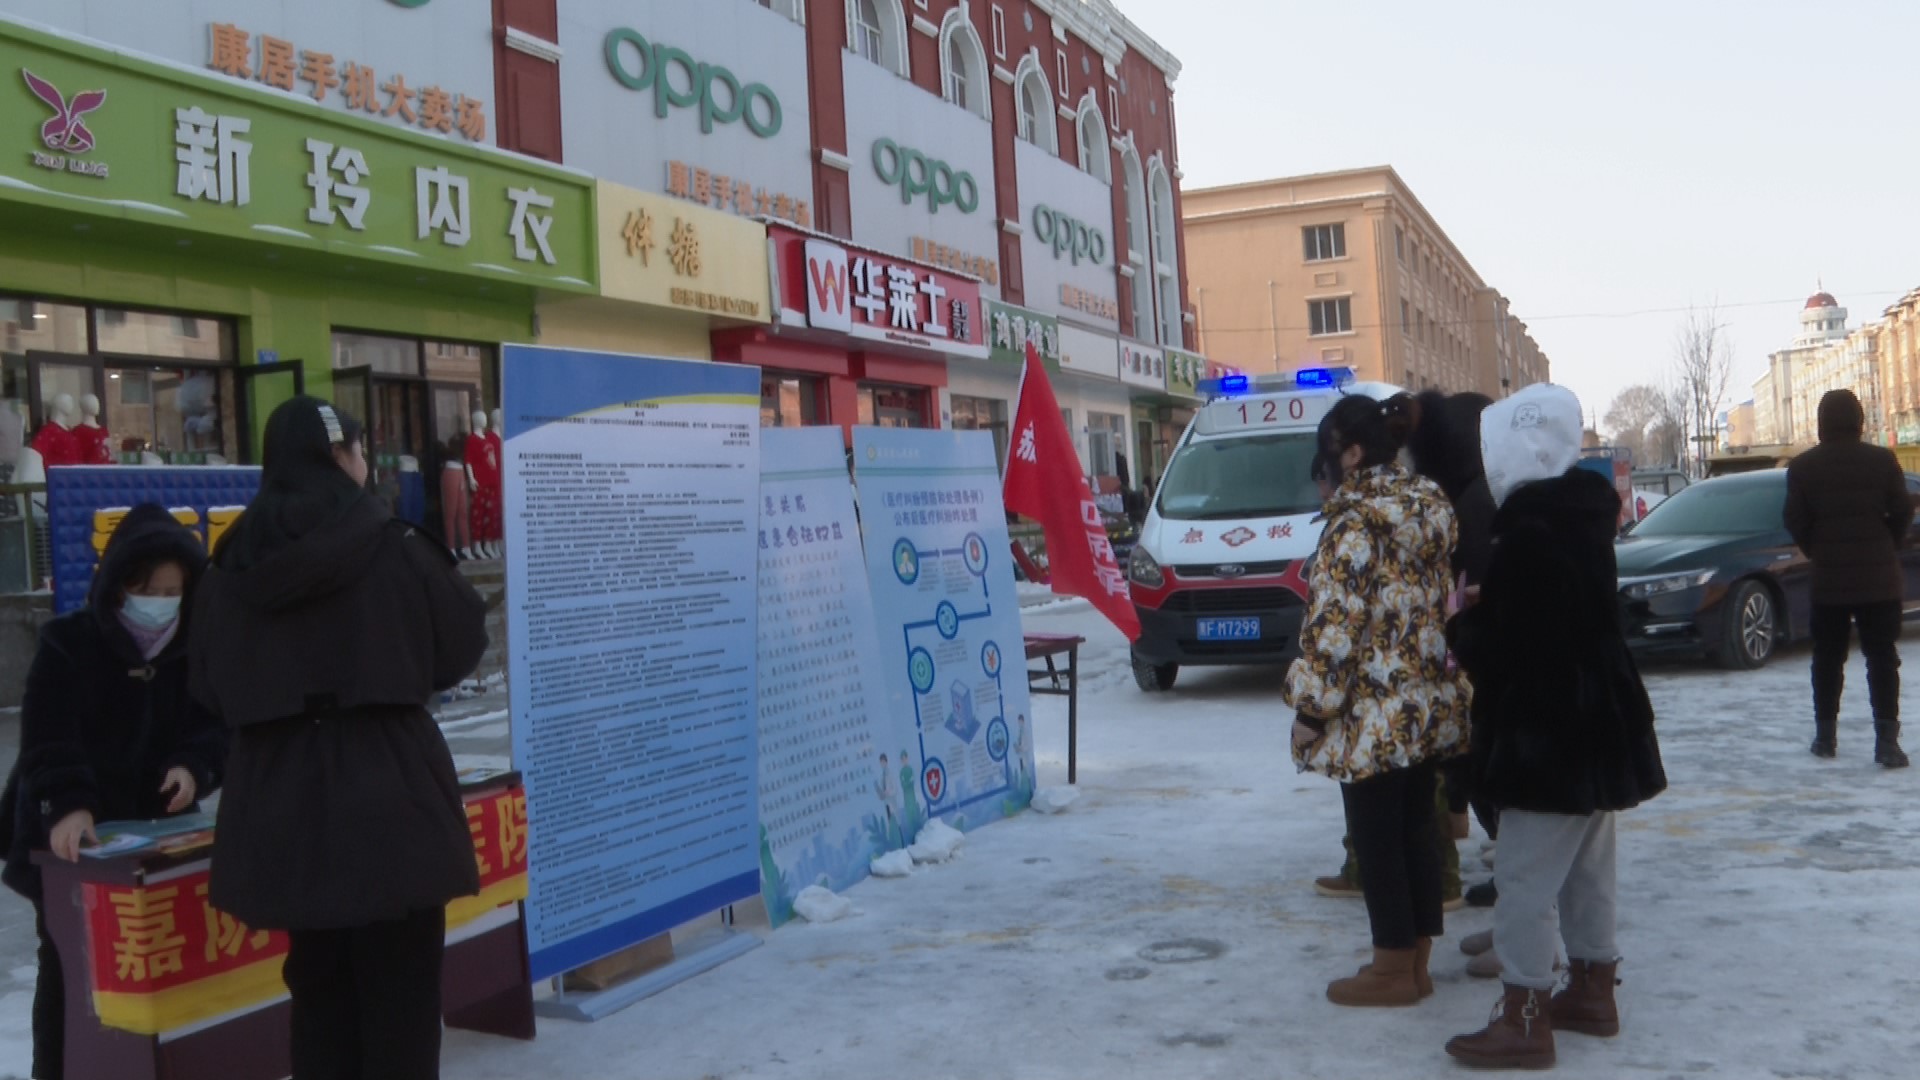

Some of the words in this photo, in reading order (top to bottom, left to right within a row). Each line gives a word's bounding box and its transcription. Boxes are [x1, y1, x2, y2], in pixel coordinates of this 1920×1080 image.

[209, 21, 486, 142] 康居手机大卖场
[174, 105, 557, 266] 新玲内衣
[852, 256, 948, 337] 华莱士
[1238, 398, 1305, 424] 120
